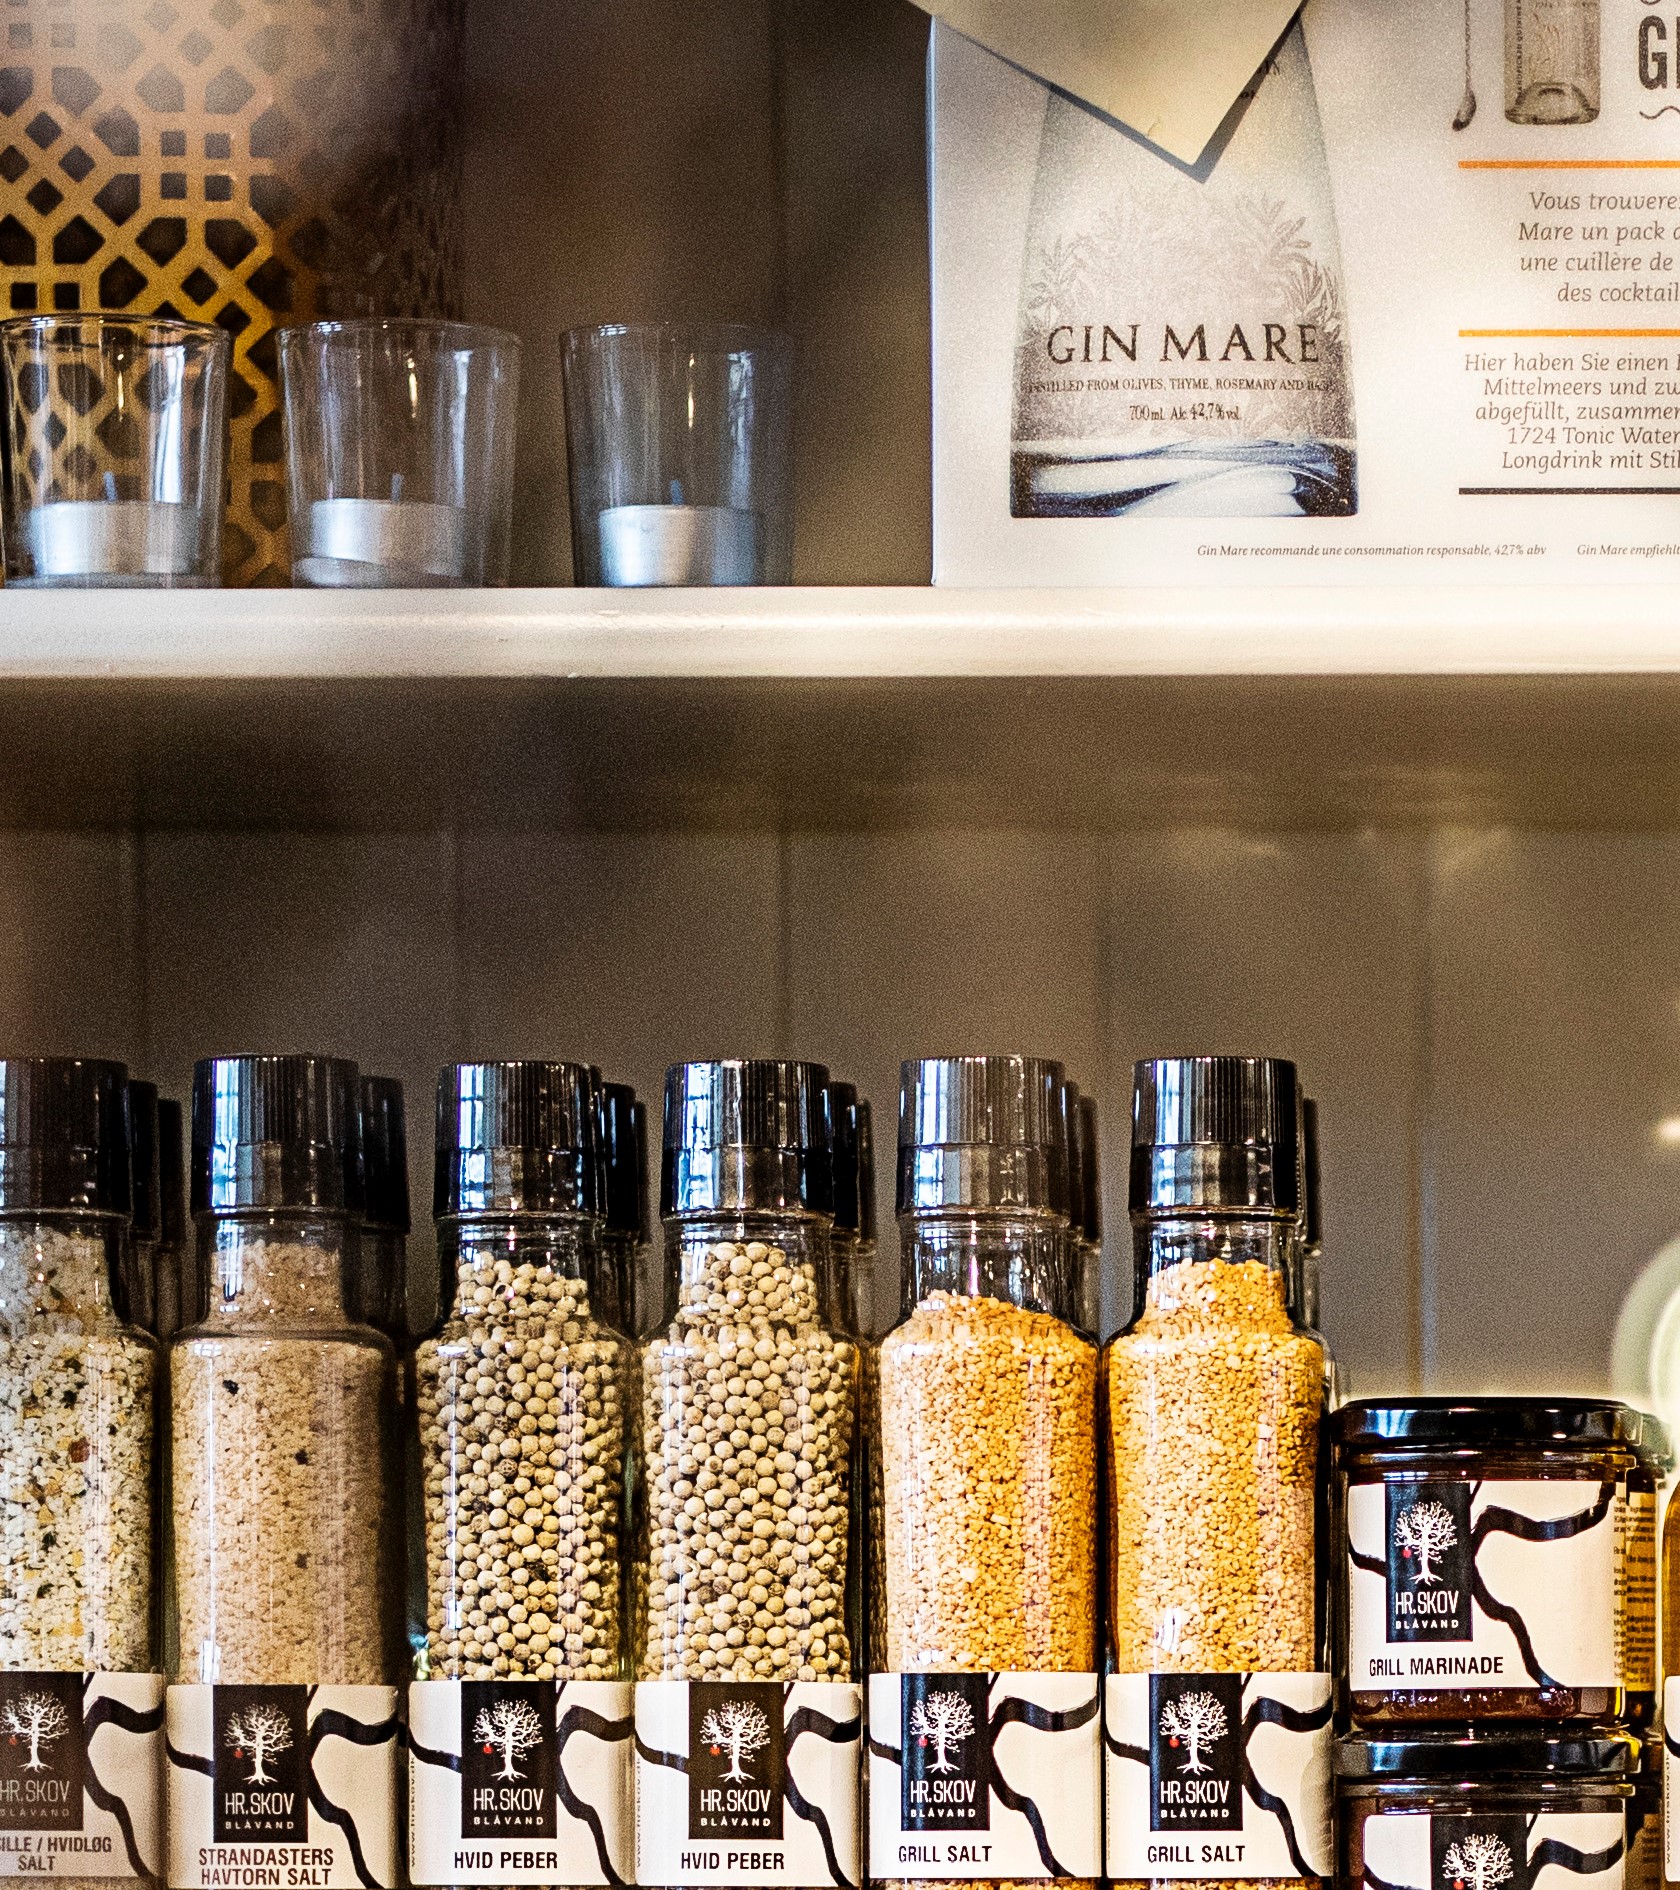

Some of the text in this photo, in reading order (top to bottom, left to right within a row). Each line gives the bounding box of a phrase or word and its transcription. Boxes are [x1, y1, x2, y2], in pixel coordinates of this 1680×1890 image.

[1528, 191, 1582, 211] Vous
[1518, 221, 1575, 242] Mare
[1581, 223, 1610, 241] un
[1616, 220, 1666, 248] pack
[1519, 255, 1559, 272] une
[1564, 251, 1643, 272] cuillère
[1648, 250, 1675, 272] de
[1557, 281, 1592, 303] des
[1043, 318, 1325, 368] GIN MARE
[1464, 353, 1507, 372] Hier
[1514, 352, 1575, 372] haben
[1580, 352, 1611, 372] Sie
[1616, 354, 1670, 372] einen
[1483, 376, 1602, 396] Mittelmeers
[1609, 377, 1648, 396] und
[1475, 400, 1571, 426] abgefüllt,
[1507, 426, 1557, 445] 1724
[1562, 426, 1615, 445] Tonic
[1501, 449, 1603, 475] Longdrink
[1610, 450, 1645, 469] mit
[473, 1787, 544, 1811] HR.SKOV
[473, 1814, 544, 1826] BLÅVAND
[36, 1836, 43, 1853] /
[47, 1836, 113, 1854] HVIDLØG
[1147, 1844, 1246, 1864] GRILL SALT
[17, 1854, 56, 1872] SALT
[198, 1847, 334, 1867] STRANDASTERS
[454, 1851, 558, 1869] HVID PEBER
[201, 1867, 332, 1886] HAVTORN SALT
